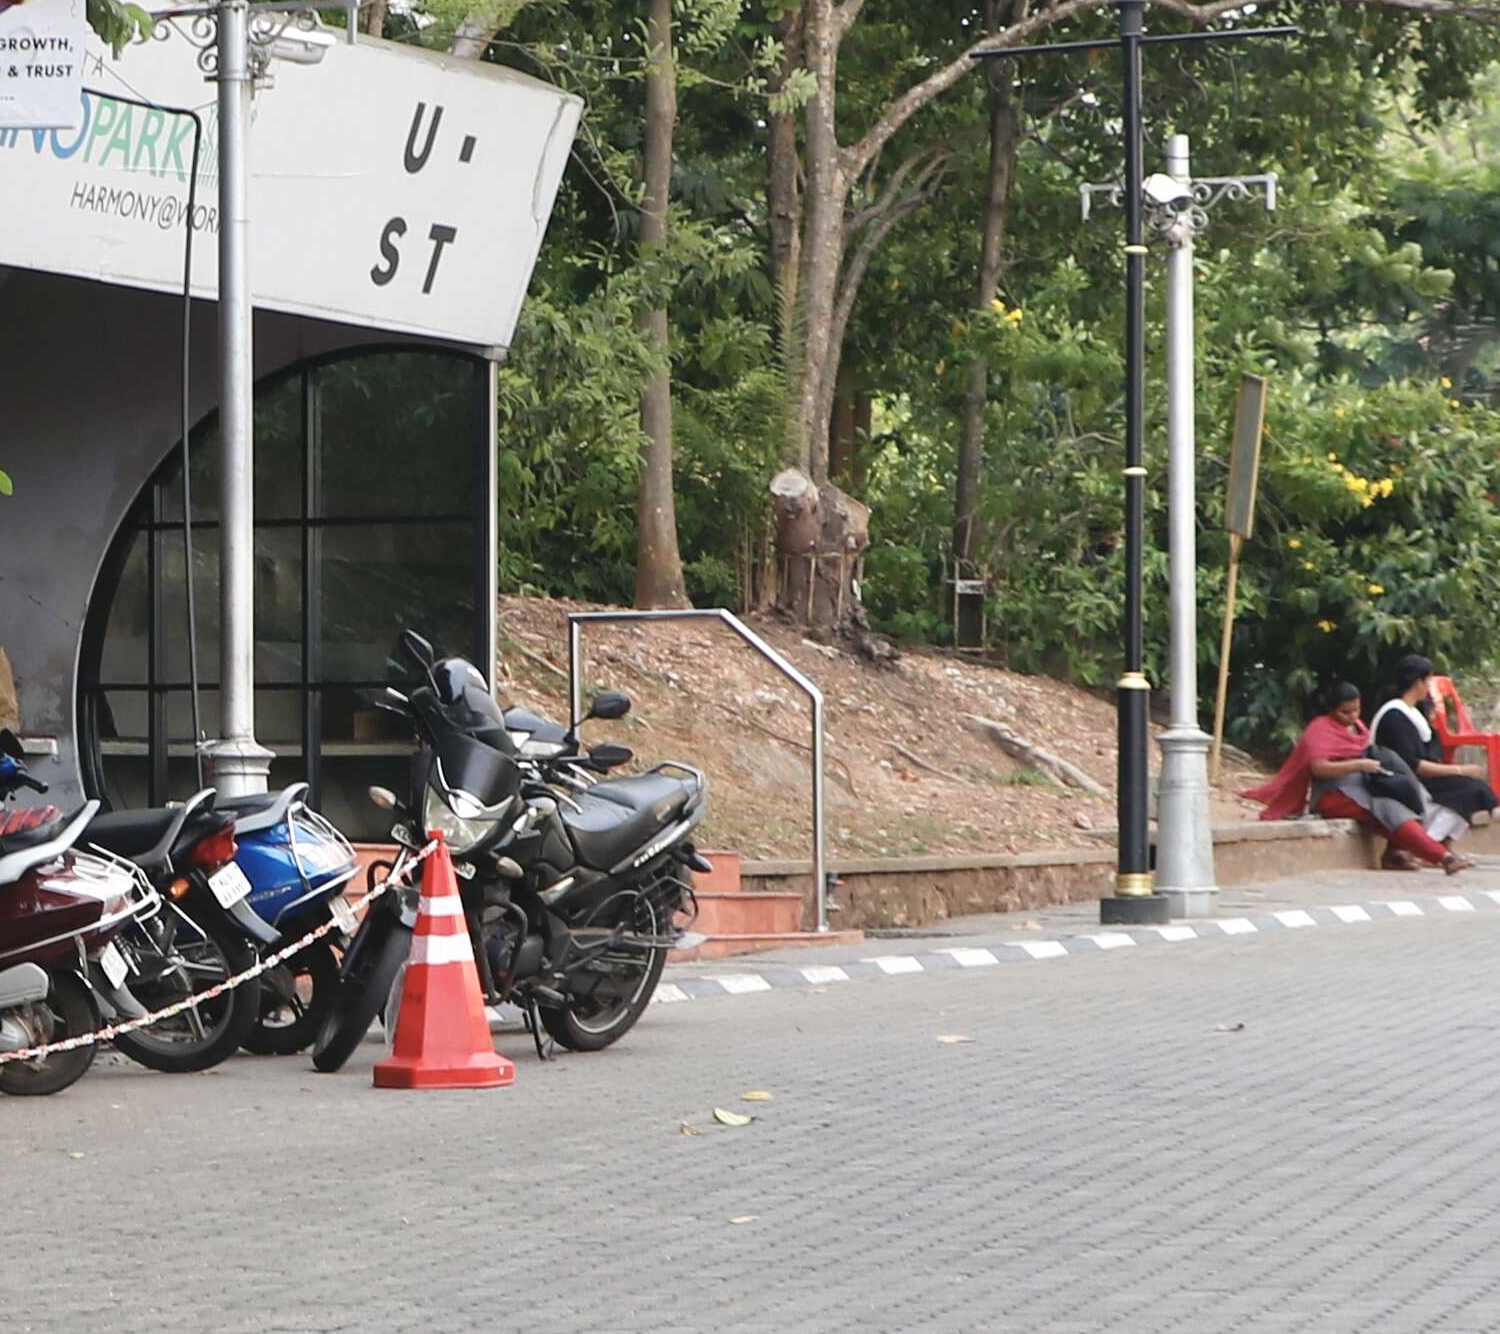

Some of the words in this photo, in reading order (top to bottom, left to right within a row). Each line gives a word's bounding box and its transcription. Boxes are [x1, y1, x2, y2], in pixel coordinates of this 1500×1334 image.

[8, 65, 19, 78] &
[27, 64, 74, 78] TRUST
[70, 180, 222, 235] HARMONY@WOR
